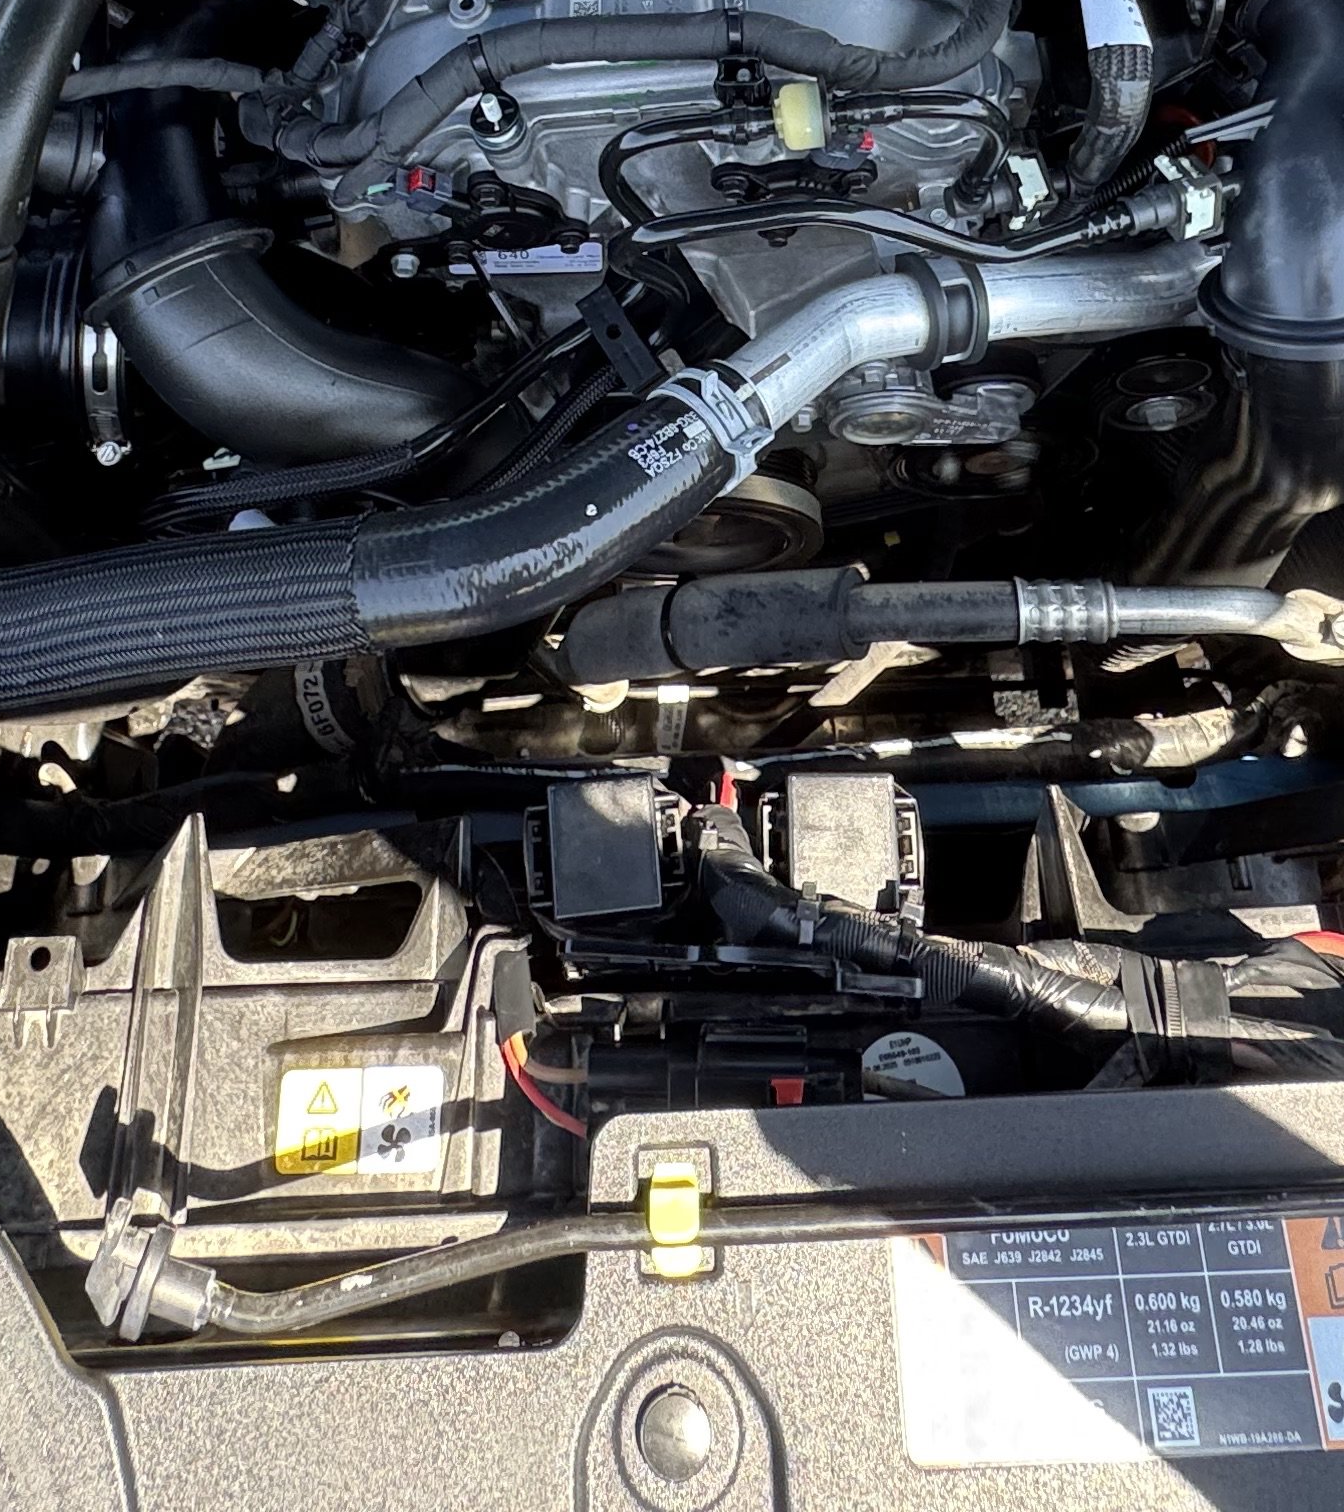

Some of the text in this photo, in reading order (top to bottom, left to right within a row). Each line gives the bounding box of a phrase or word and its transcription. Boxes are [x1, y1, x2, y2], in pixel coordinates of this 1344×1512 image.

[1125, 1230, 1192, 1247] 2.3L GTDI
[1228, 1239, 1262, 1256] GTDI
[962, 1247, 1104, 1265] SAE J639 J2842 J2845
[1027, 1292, 1113, 1322] R-1234yf
[1134, 1291, 1201, 1313] 0.600 kg
[1220, 1288, 1287, 1310] 0.580 kg
[1147, 1317, 1196, 1334] 21.16 oz
[1231, 1315, 1284, 1332] 20.46 oz
[1064, 1343, 1120, 1365] (GWP 4)
[1151, 1340, 1199, 1358] 1.32 lbs
[1237, 1337, 1285, 1355] 1.28 lbs
